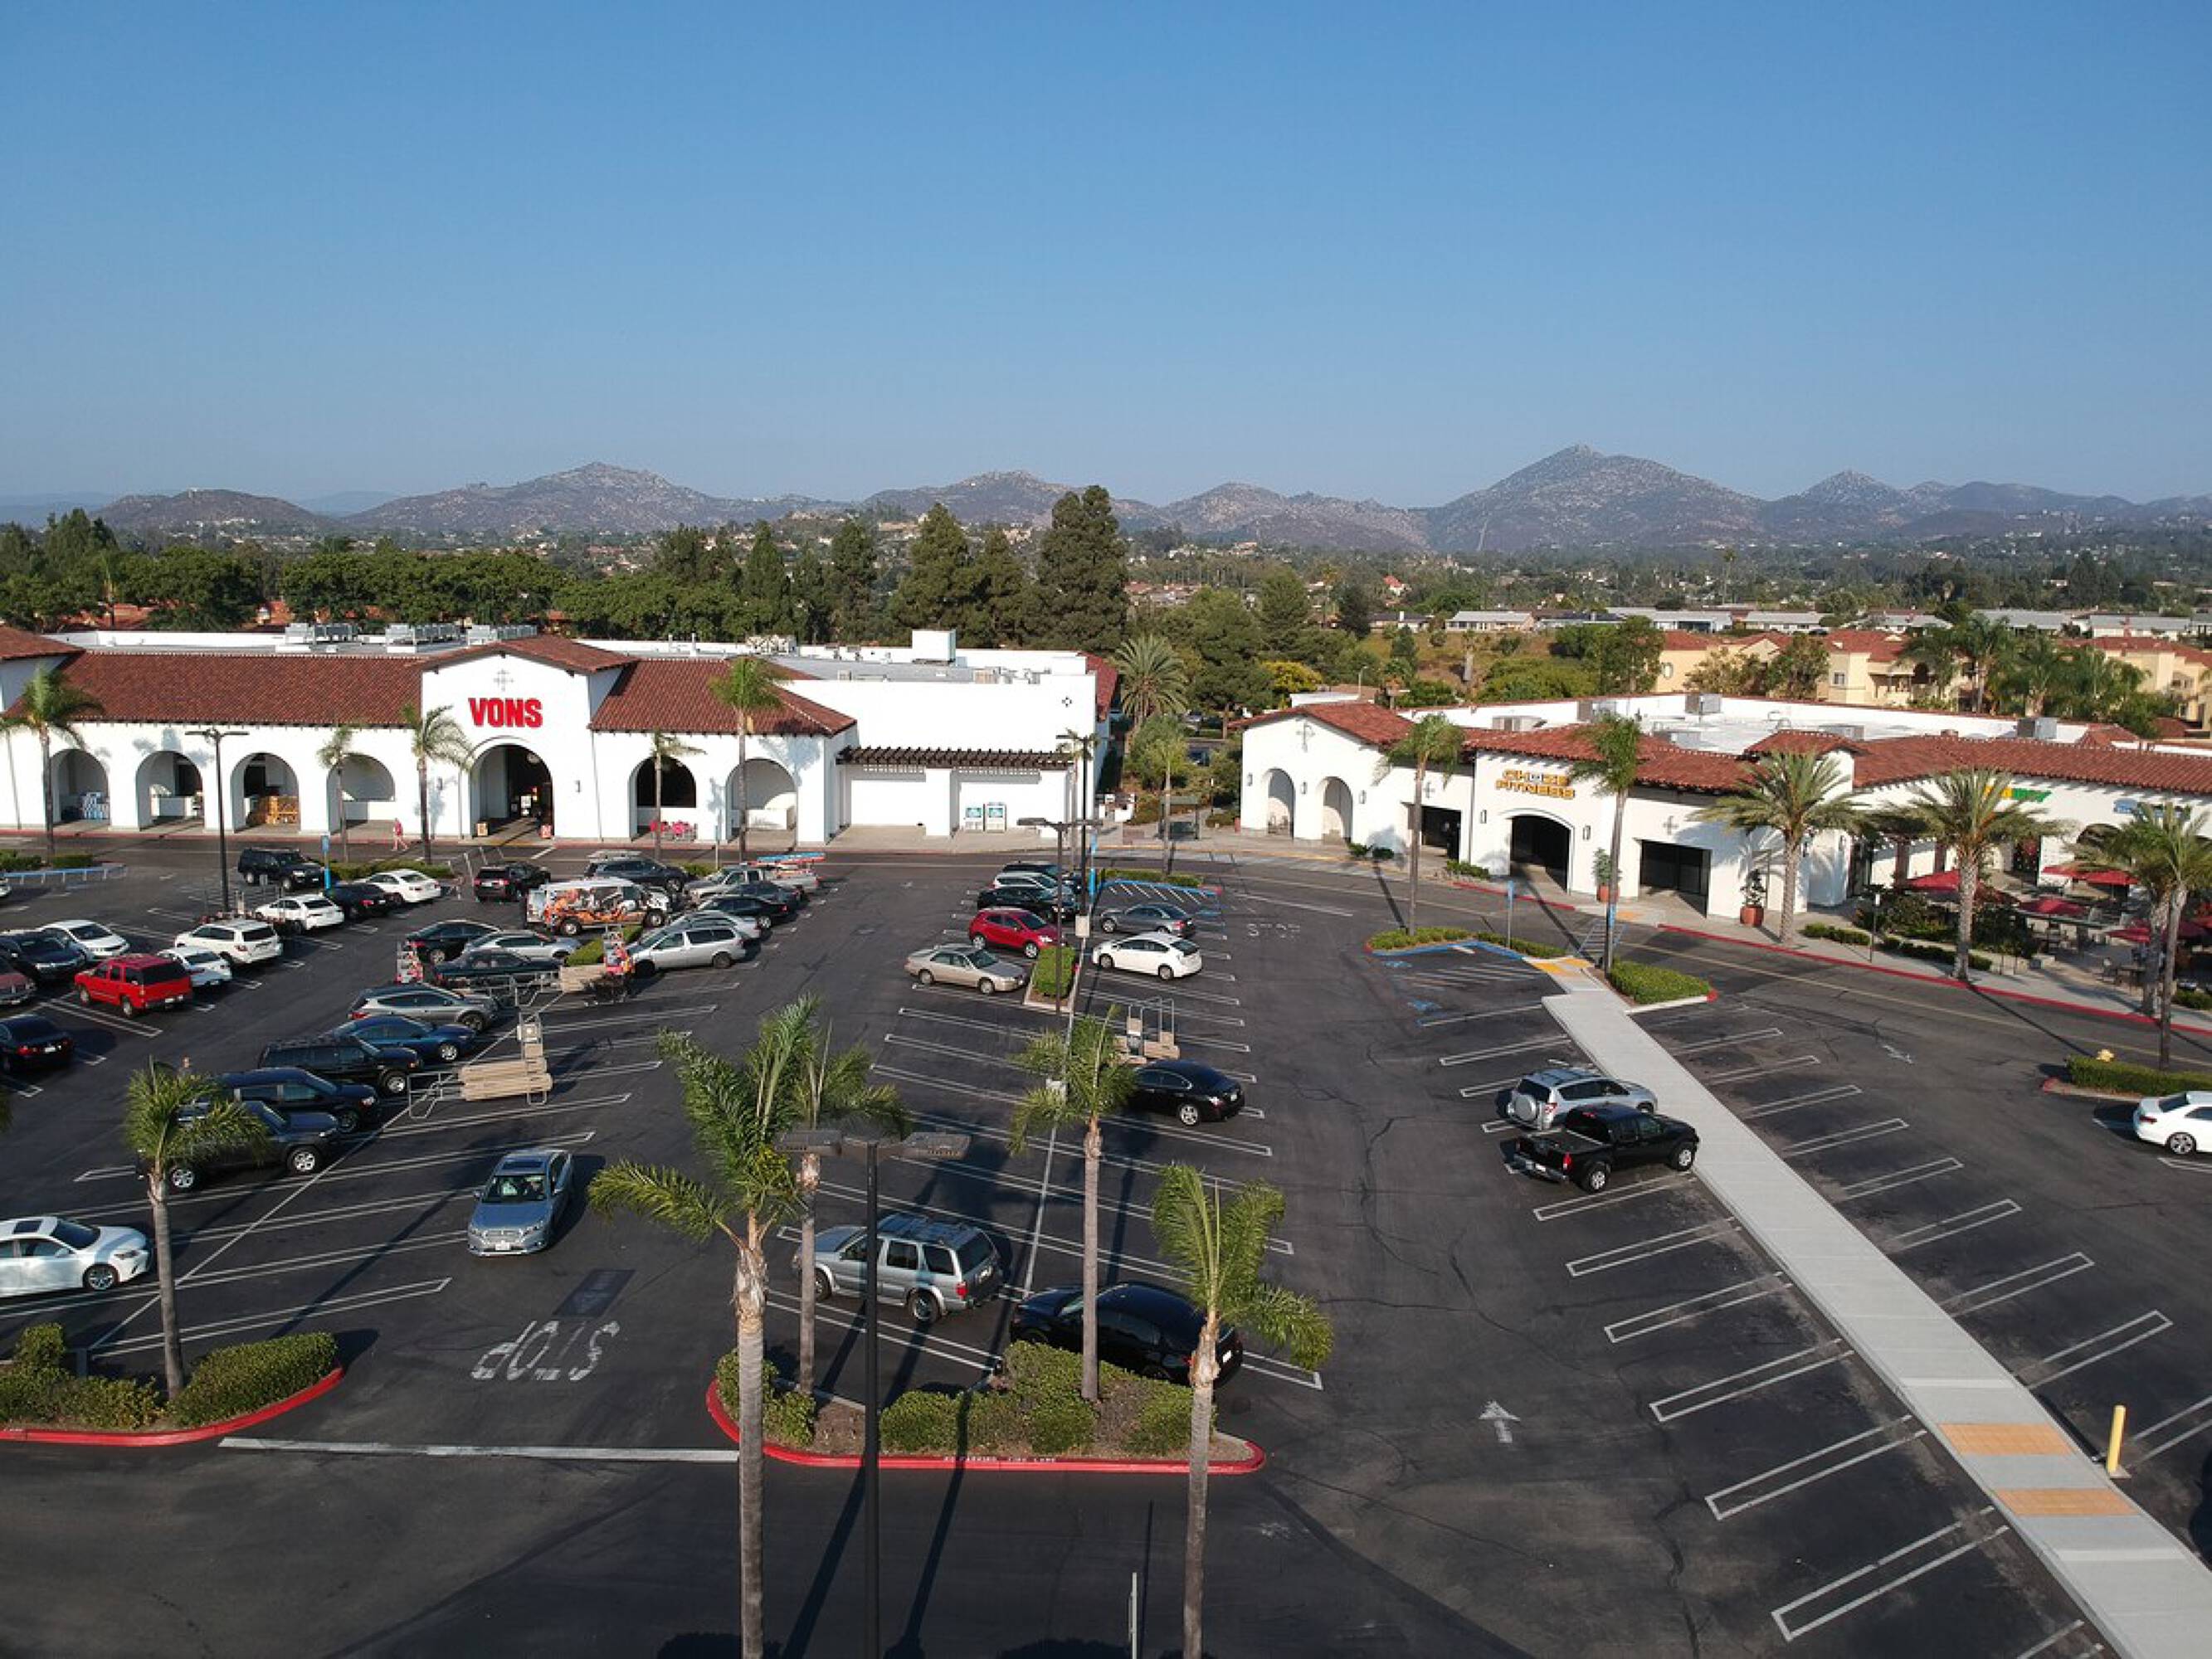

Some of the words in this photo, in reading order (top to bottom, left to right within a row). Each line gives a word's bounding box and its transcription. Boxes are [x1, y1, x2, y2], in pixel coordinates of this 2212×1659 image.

[468, 698, 543, 727] VONS
[1496, 780, 1576, 800] FITNESS
[471, 1321, 620, 1380] STOP
